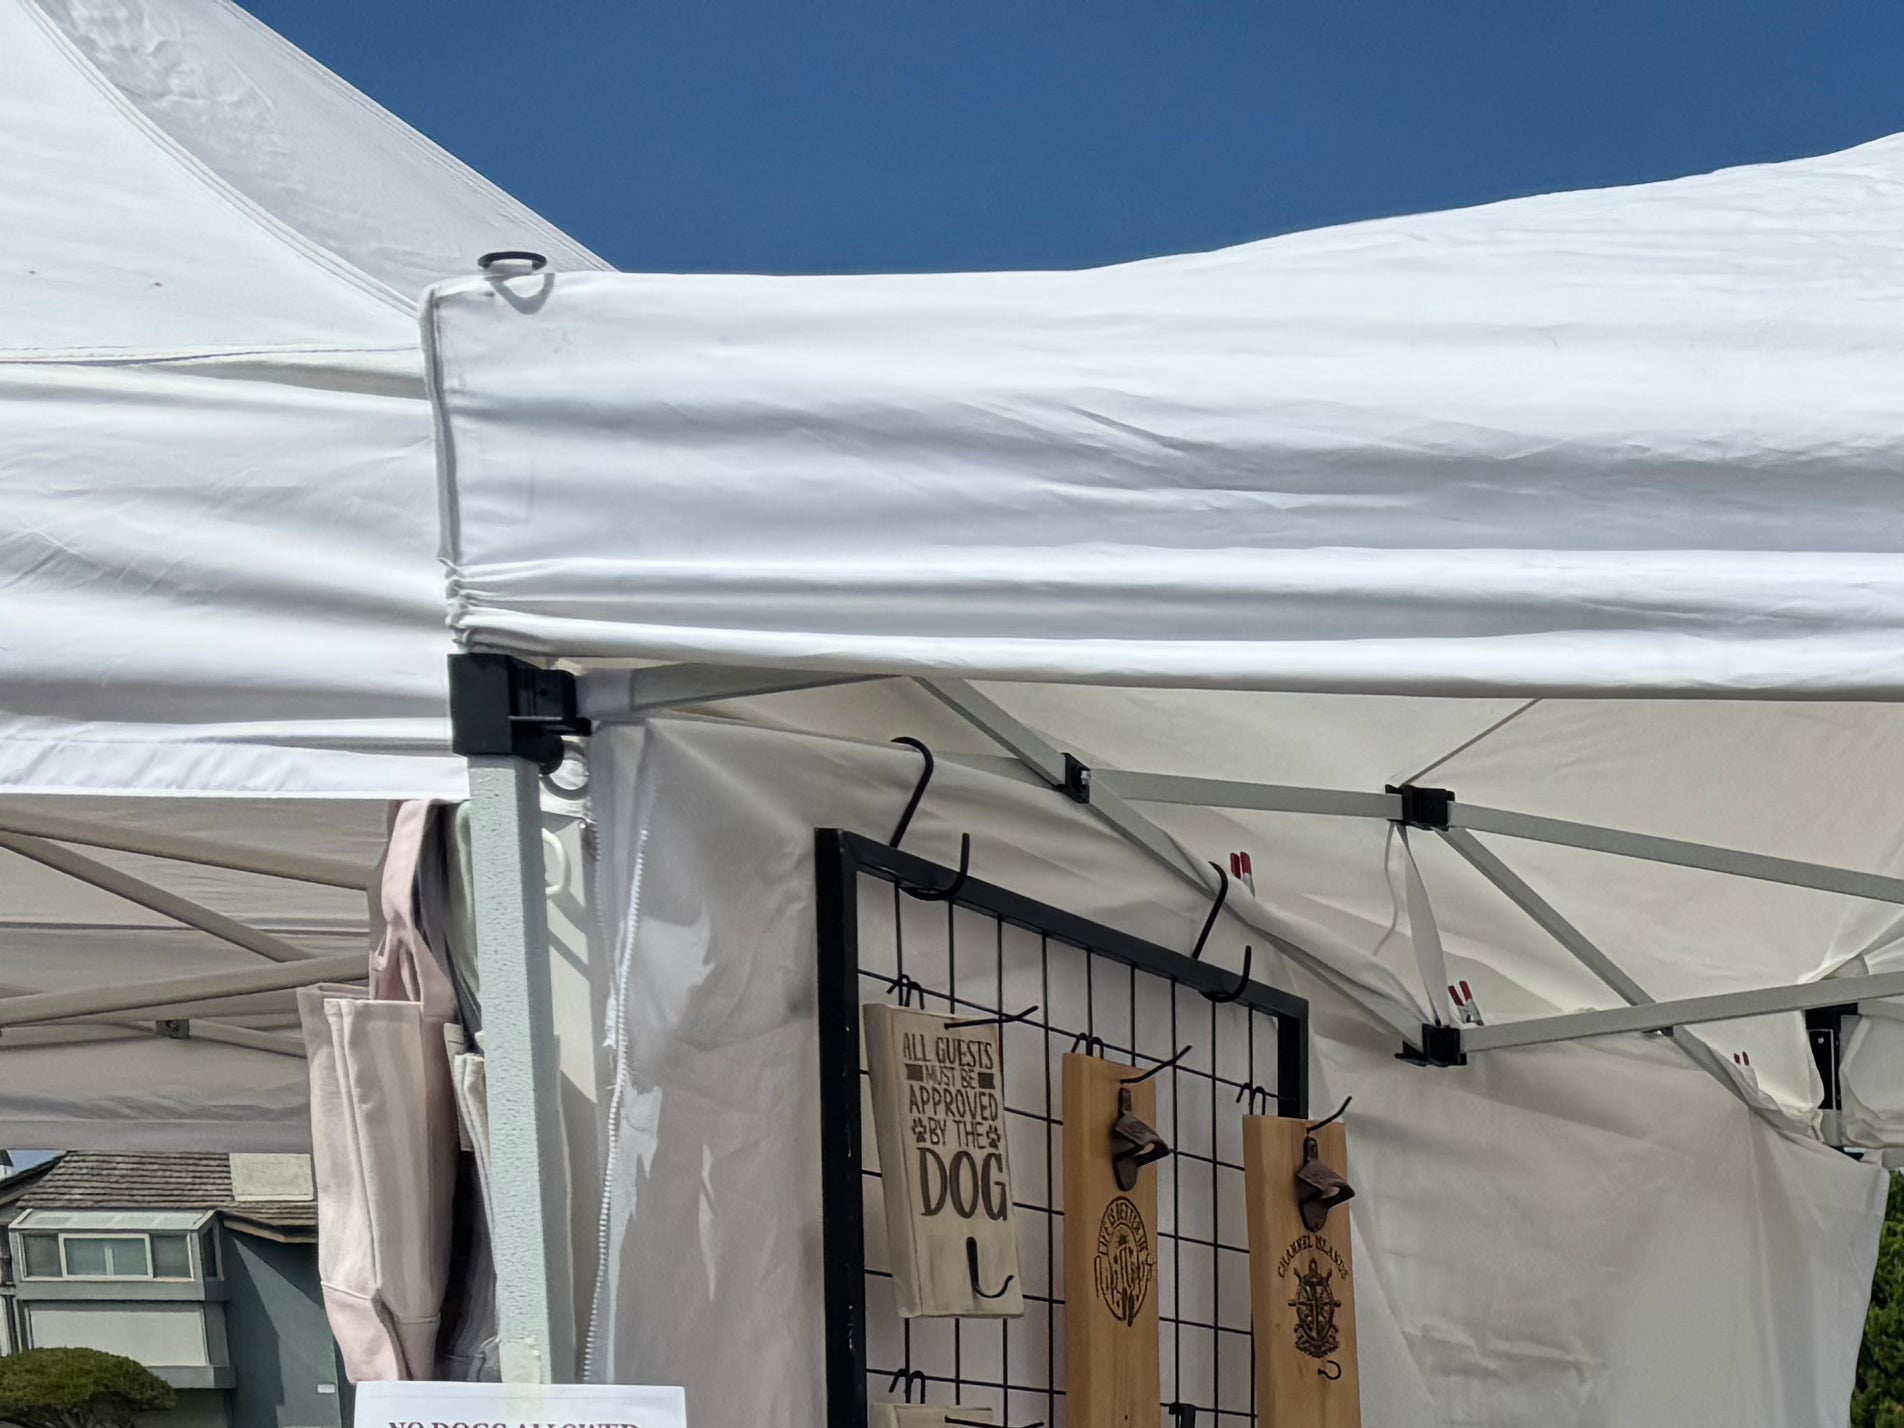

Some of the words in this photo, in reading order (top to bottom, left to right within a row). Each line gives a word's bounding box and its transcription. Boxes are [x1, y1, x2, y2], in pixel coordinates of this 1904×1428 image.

[903, 1033, 932, 1061] ALL
[936, 1037, 993, 1070] GUESTS
[925, 1065, 955, 1087] MUST
[961, 1067, 976, 1089] BE
[909, 1084, 998, 1121] APPROVED
[929, 1117, 947, 1146] BY
[953, 1120, 986, 1149] THE
[917, 1147, 1007, 1221] DOG
